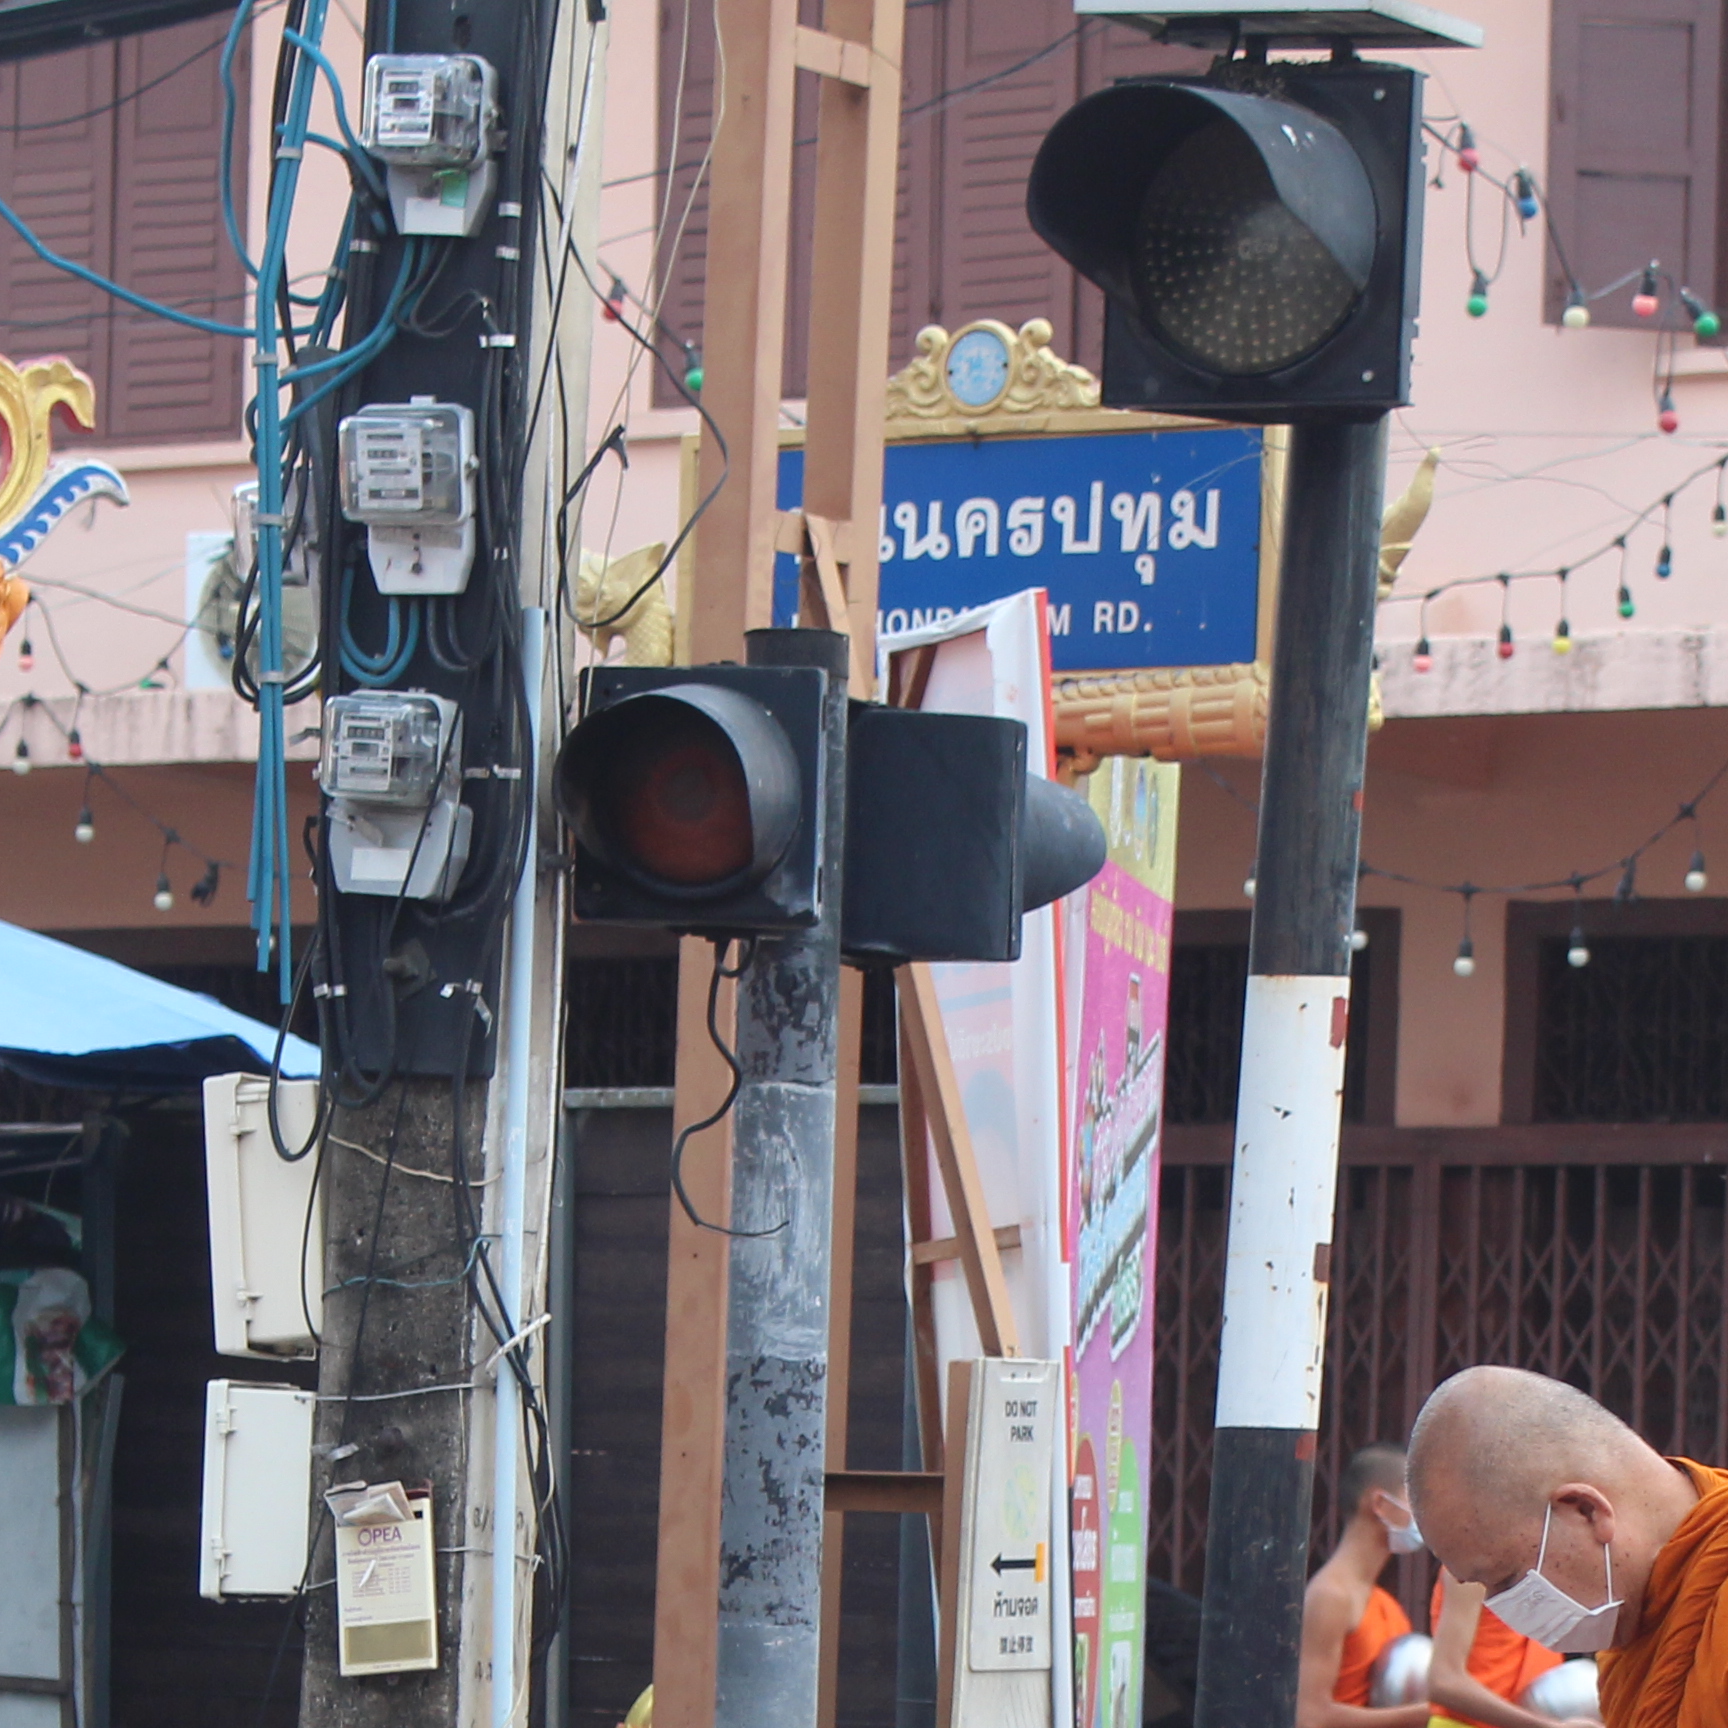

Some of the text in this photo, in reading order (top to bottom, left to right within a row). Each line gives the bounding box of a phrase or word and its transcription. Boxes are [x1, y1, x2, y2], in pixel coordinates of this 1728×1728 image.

[791, 481, 1220, 585] นครปทุม
[1094, 601, 1152, 634] RD.
[1005, 1400, 1037, 1417] DO NOT
[1010, 1425, 1033, 1442] PARK
[373, 1526, 402, 1543] PEA
[994, 1591, 1038, 1617] ห้ามจอด
